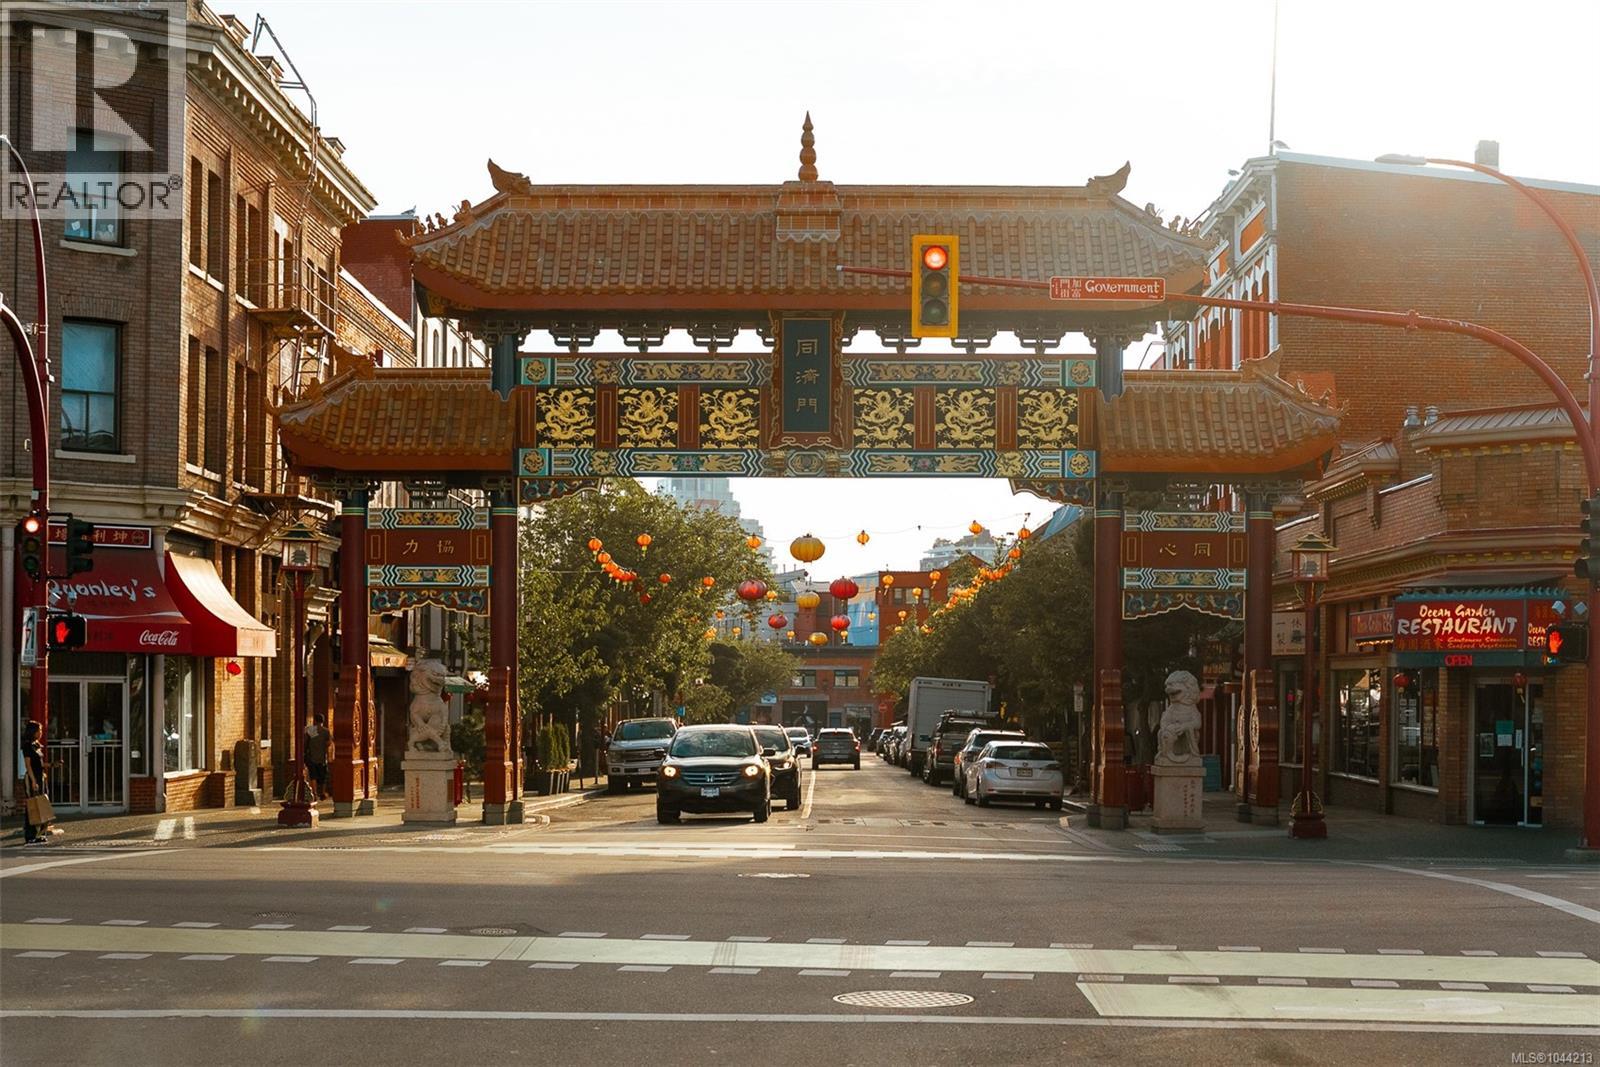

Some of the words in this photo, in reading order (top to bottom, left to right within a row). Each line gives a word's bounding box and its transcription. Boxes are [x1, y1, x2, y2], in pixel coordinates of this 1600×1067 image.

[1085, 280, 1160, 294] Government
[1419, 604, 1451, 618] Ocean
[1455, 603, 1496, 618] Garden
[1397, 617, 1518, 636] RESTAURANT
[1444, 654, 1473, 667] OPEN
